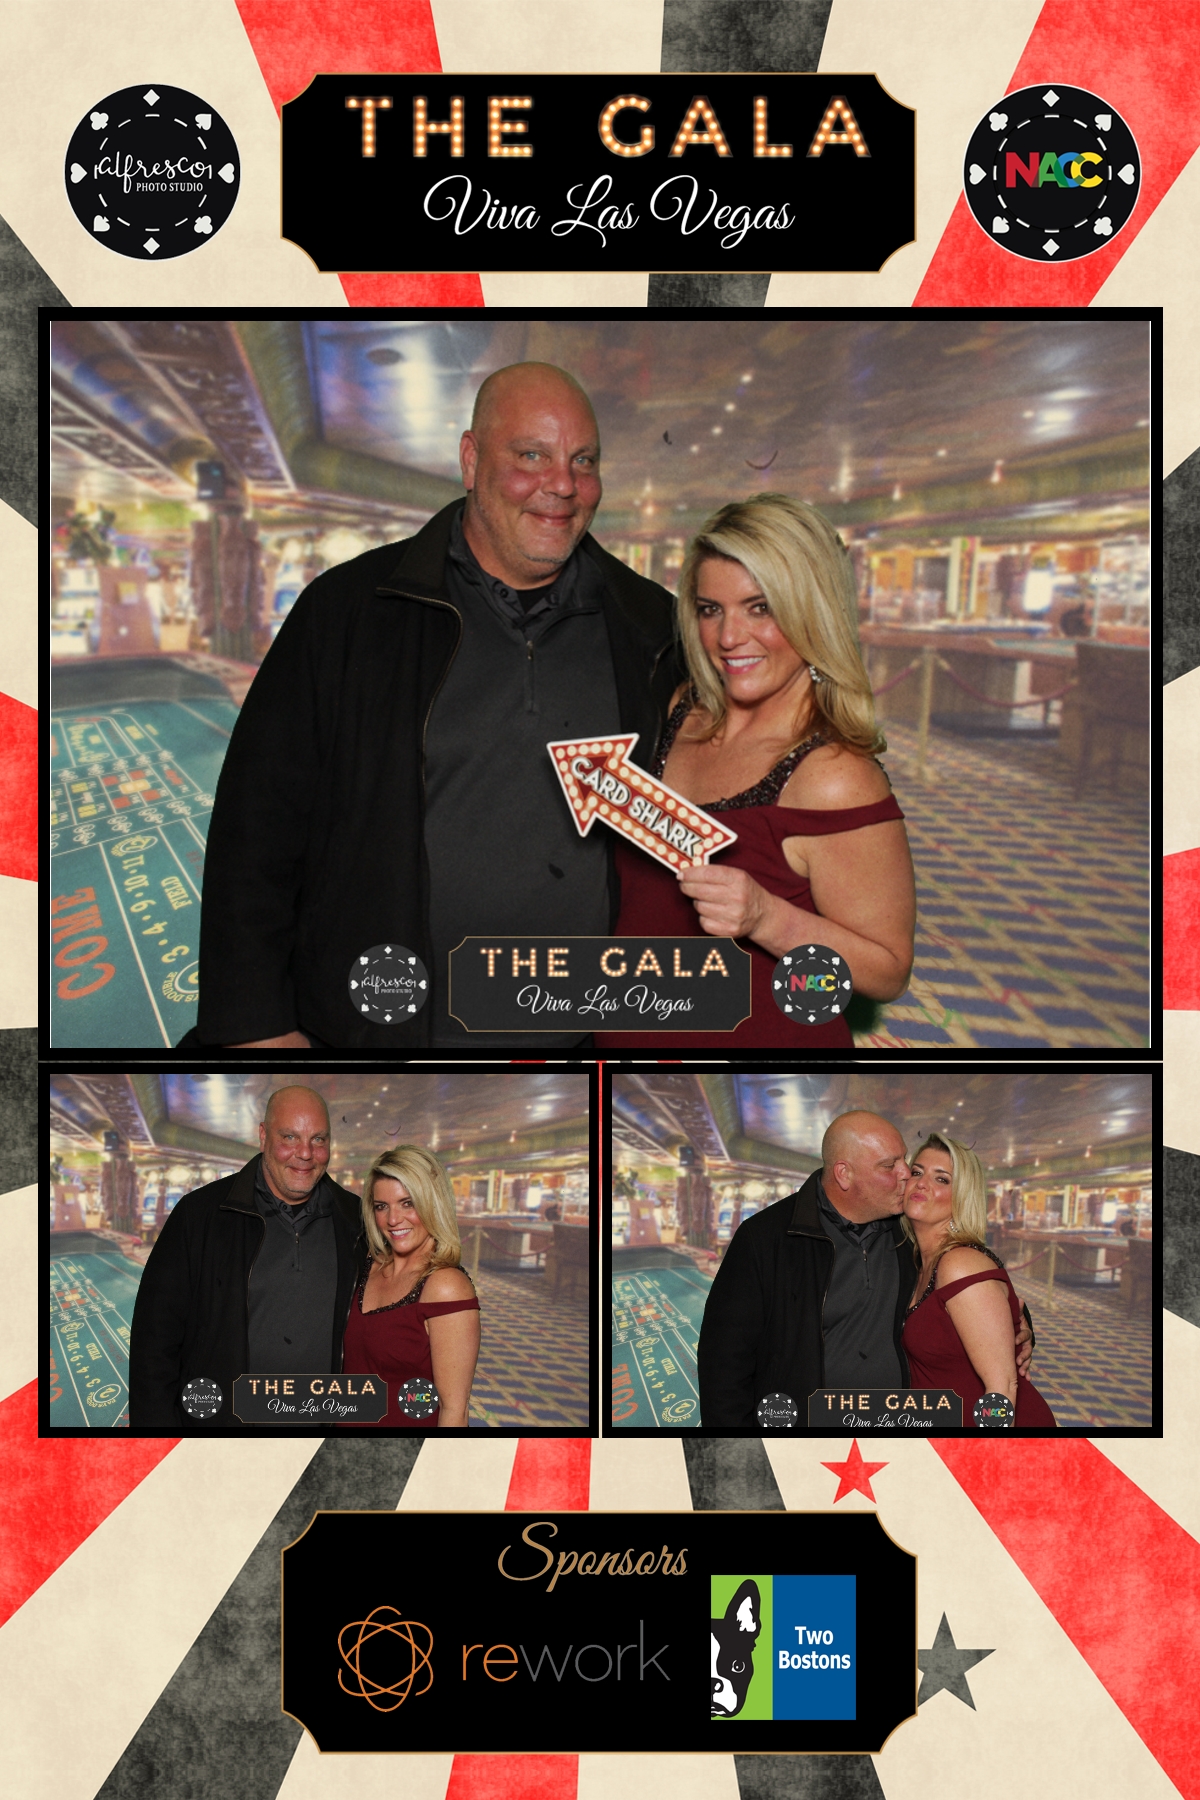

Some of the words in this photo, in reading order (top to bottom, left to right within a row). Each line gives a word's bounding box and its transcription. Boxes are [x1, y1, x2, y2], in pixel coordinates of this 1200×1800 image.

[571, 757, 630, 806] CARD
[628, 795, 703, 858] SHARK
[51, 886, 116, 1000] COME
[160, 875, 193, 910] FIELD
